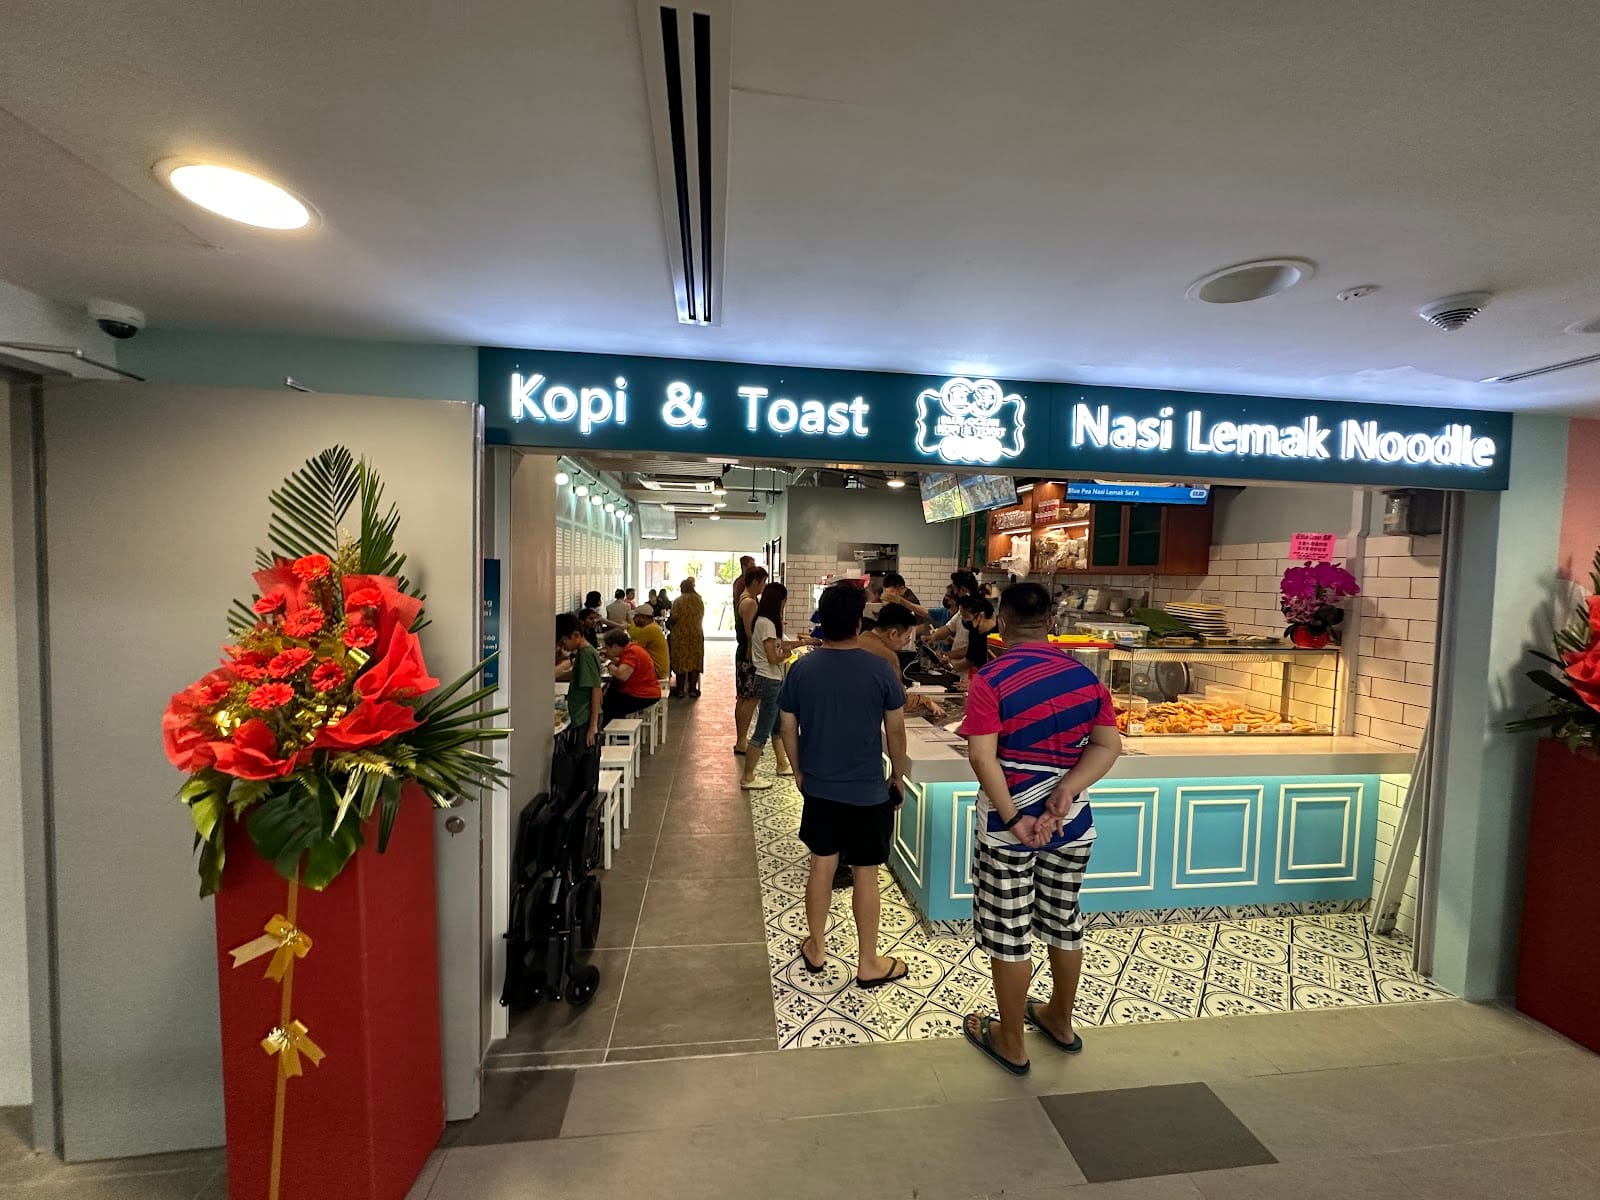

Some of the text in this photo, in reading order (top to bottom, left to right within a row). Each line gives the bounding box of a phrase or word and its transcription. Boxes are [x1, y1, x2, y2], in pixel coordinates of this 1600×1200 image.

[511, 372, 870, 437] Kopi & Toast
[1072, 403, 1496, 467] Nasi Lemak Noodle
[1081, 487, 1091, 495] Pea
[1106, 488, 1124, 496] Lemak
